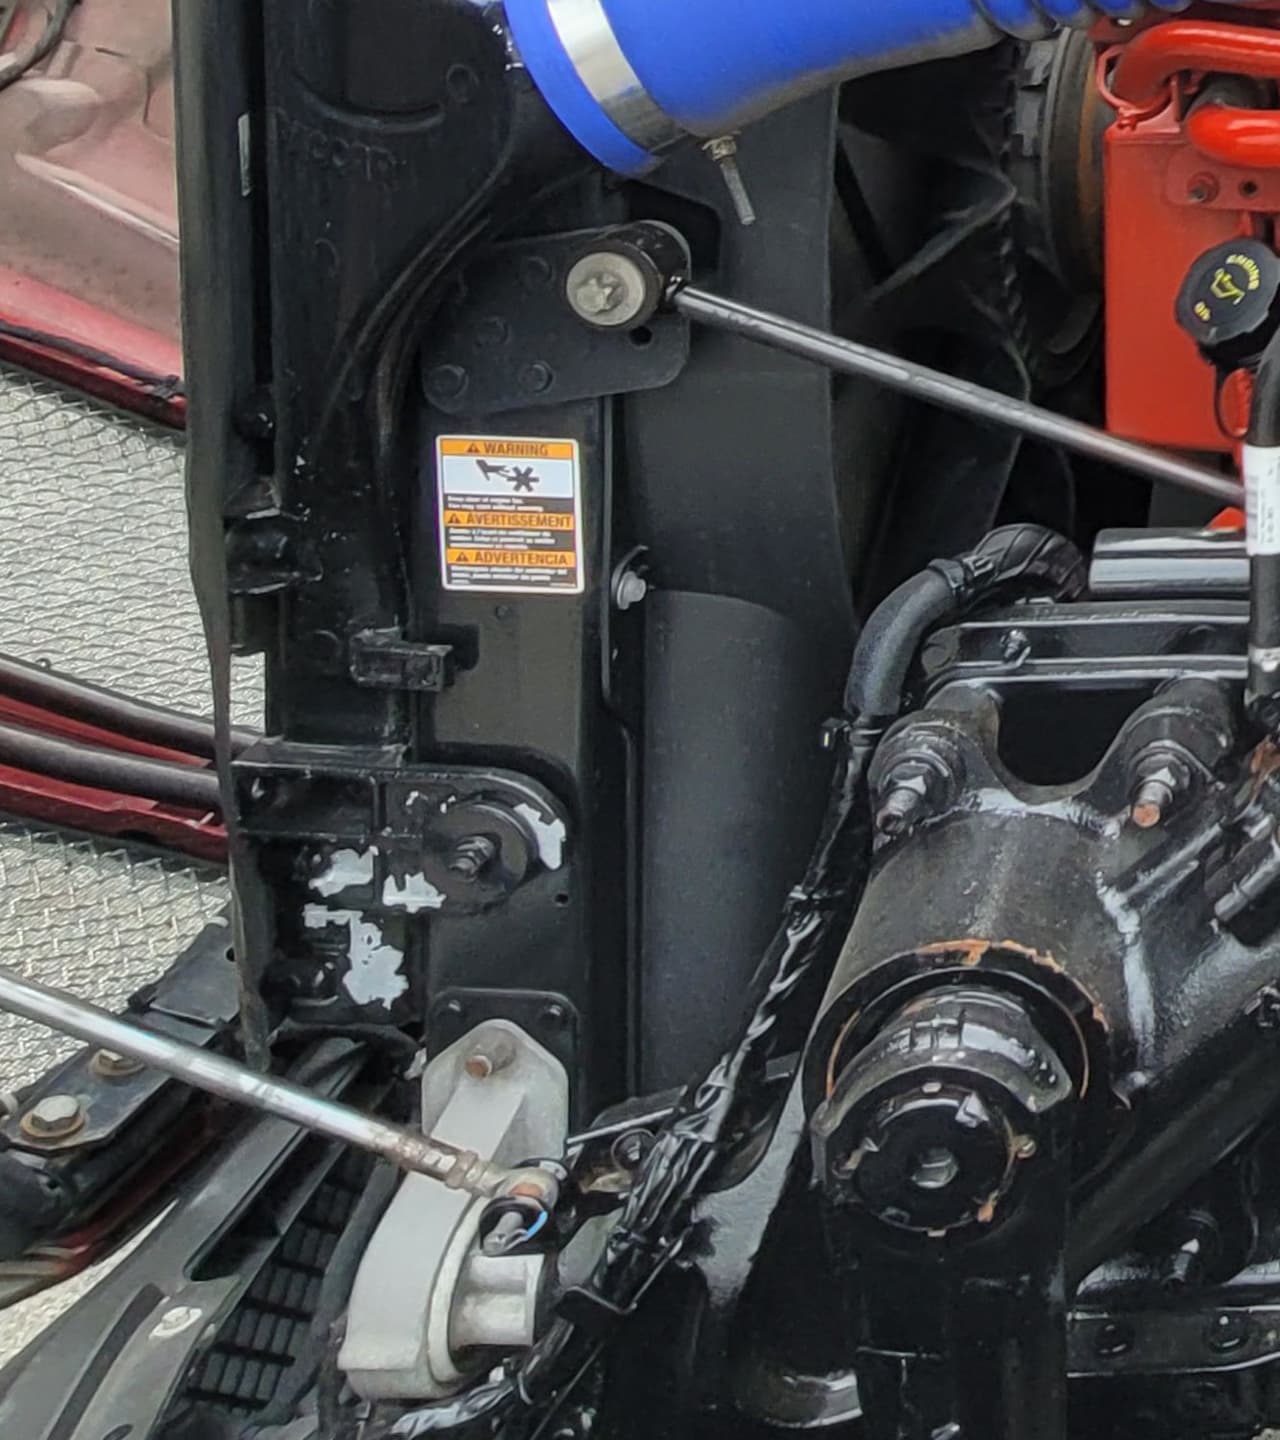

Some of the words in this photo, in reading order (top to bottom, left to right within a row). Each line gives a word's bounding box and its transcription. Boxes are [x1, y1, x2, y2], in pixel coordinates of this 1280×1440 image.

[1225, 254, 1260, 291] ENGINE
[484, 442, 549, 457] WARNING
[466, 514, 571, 528] AVERTISSEMENT
[474, 551, 568, 565] ADVERTENCIA
